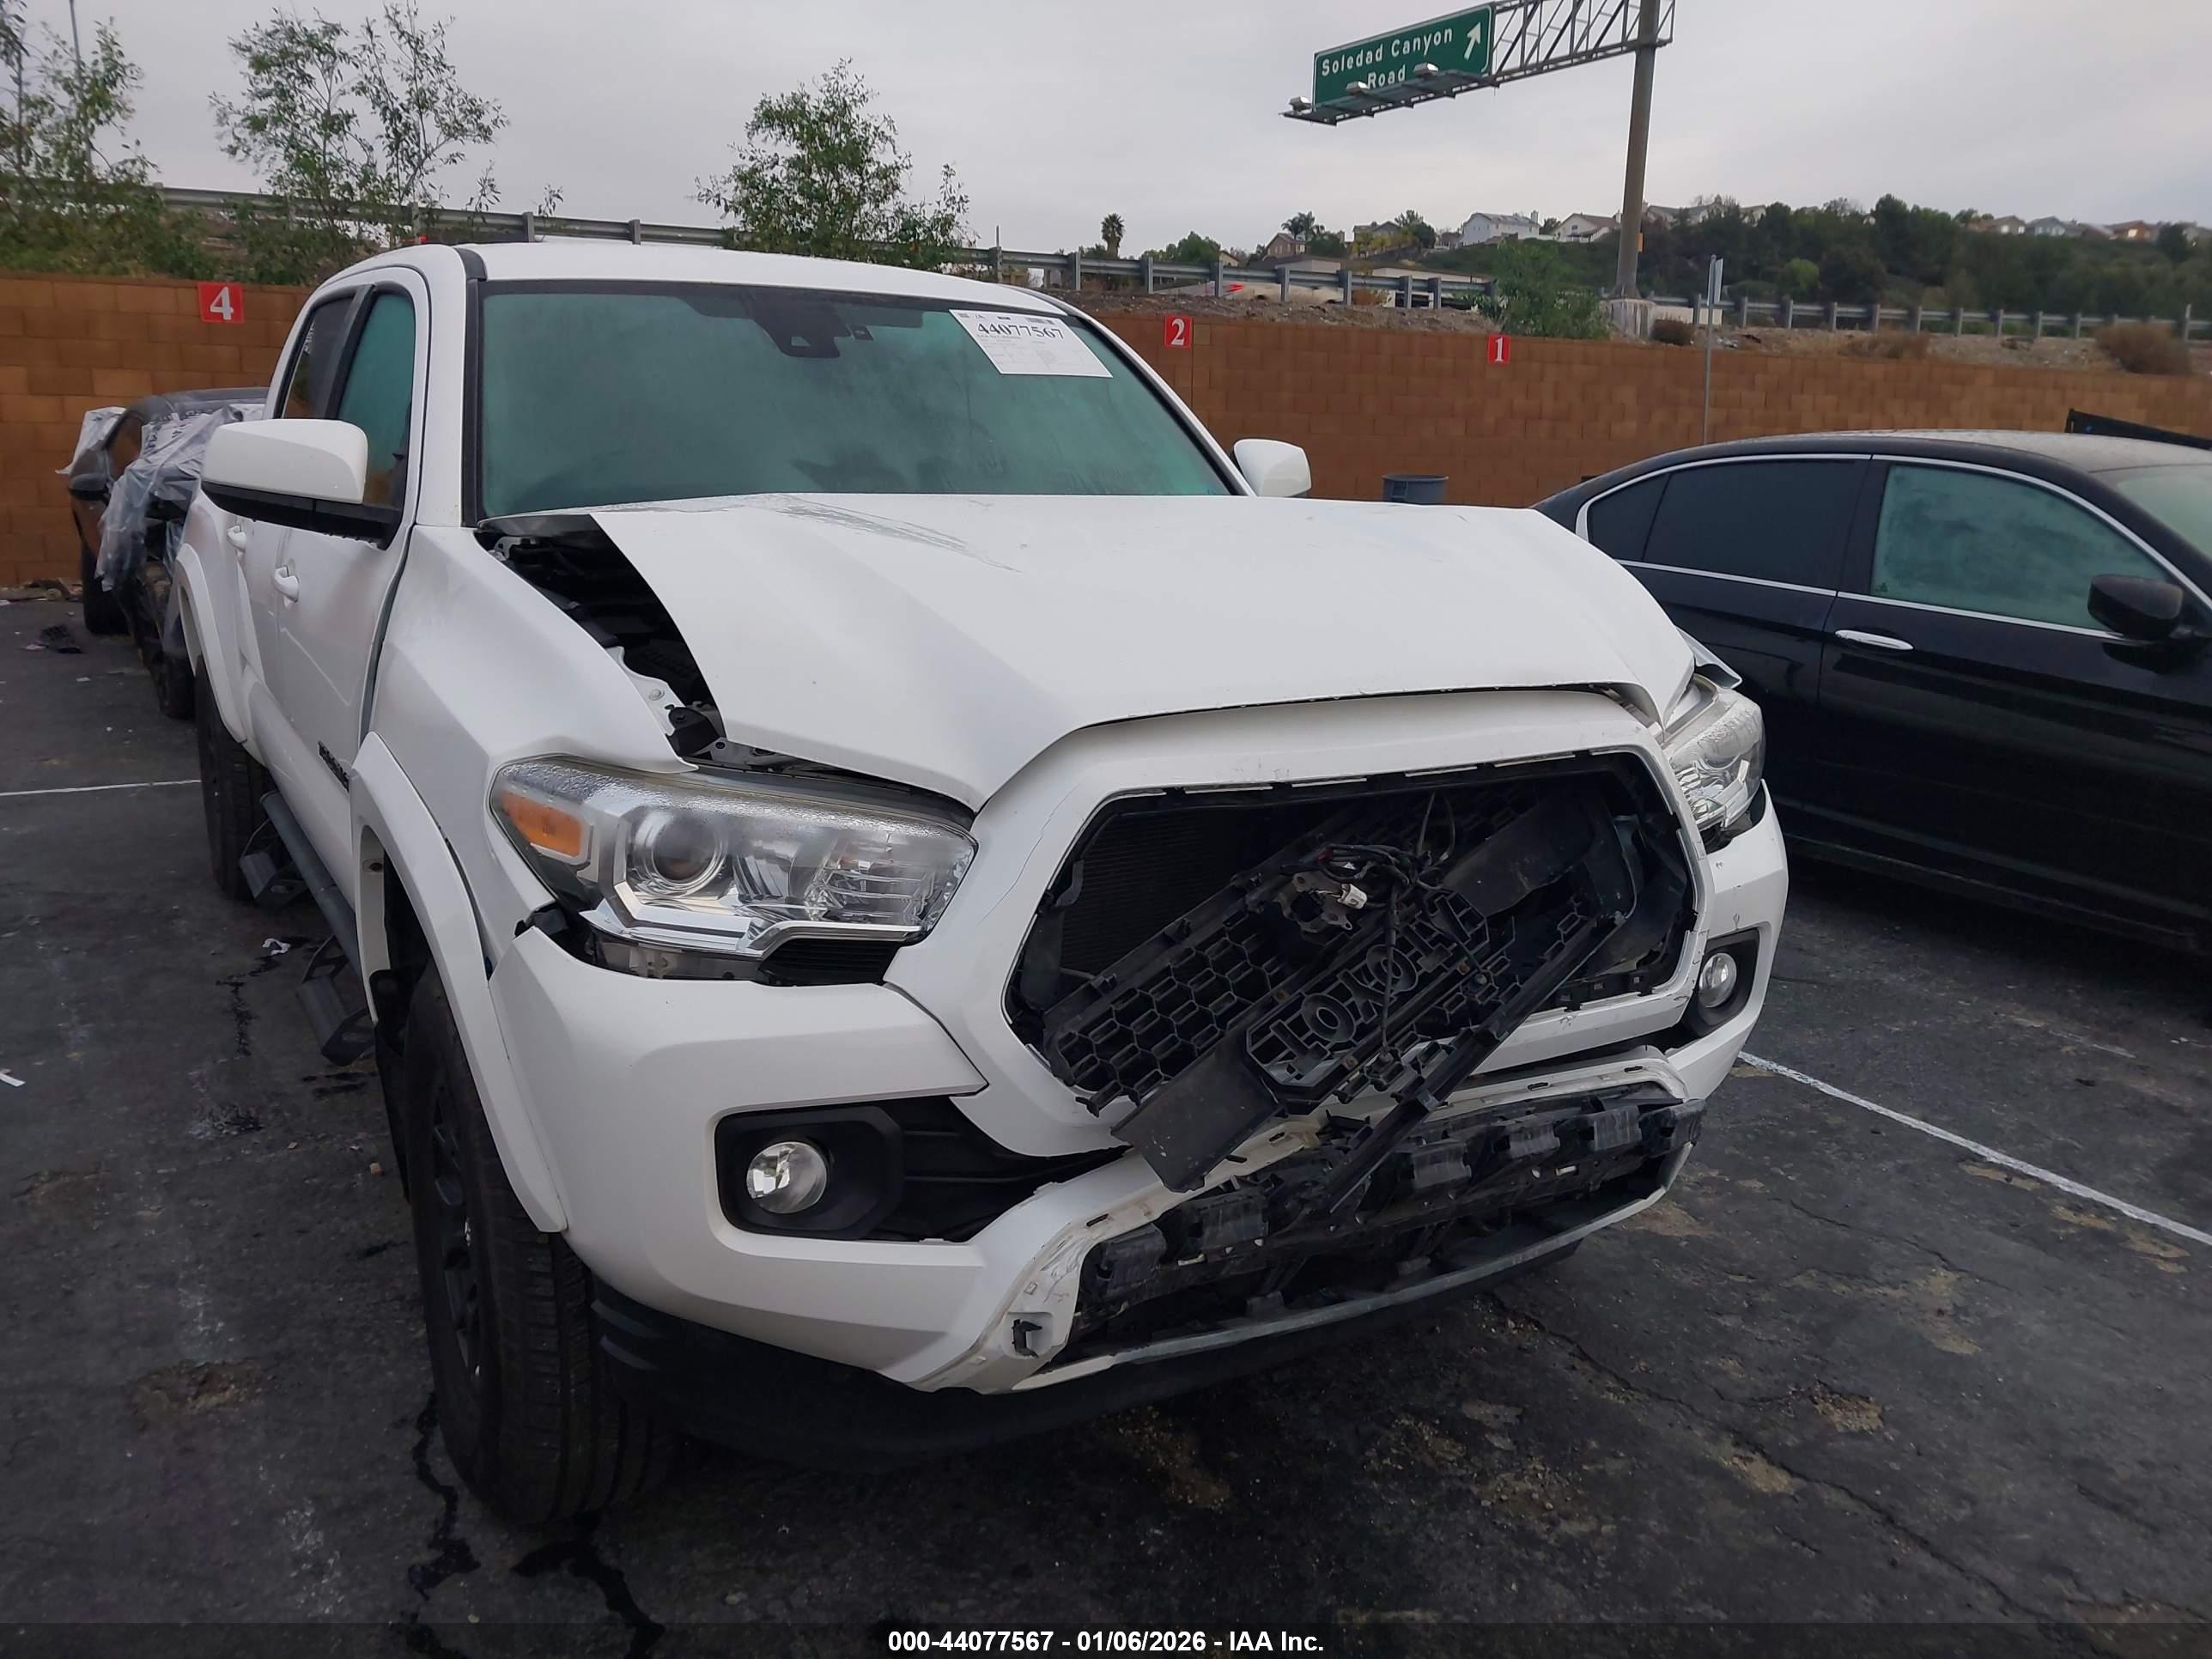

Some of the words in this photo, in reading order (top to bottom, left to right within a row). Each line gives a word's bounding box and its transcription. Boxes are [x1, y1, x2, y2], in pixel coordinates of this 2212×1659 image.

[1322, 45, 1383, 76] Soledad
[1391, 27, 1453, 56] Canyon
[1367, 64, 1407, 89] Road
[210, 287, 234, 320] 4
[977, 322, 1064, 340] 44077567
[1171, 319, 1185, 345] 2
[1495, 337, 1504, 362] 1
